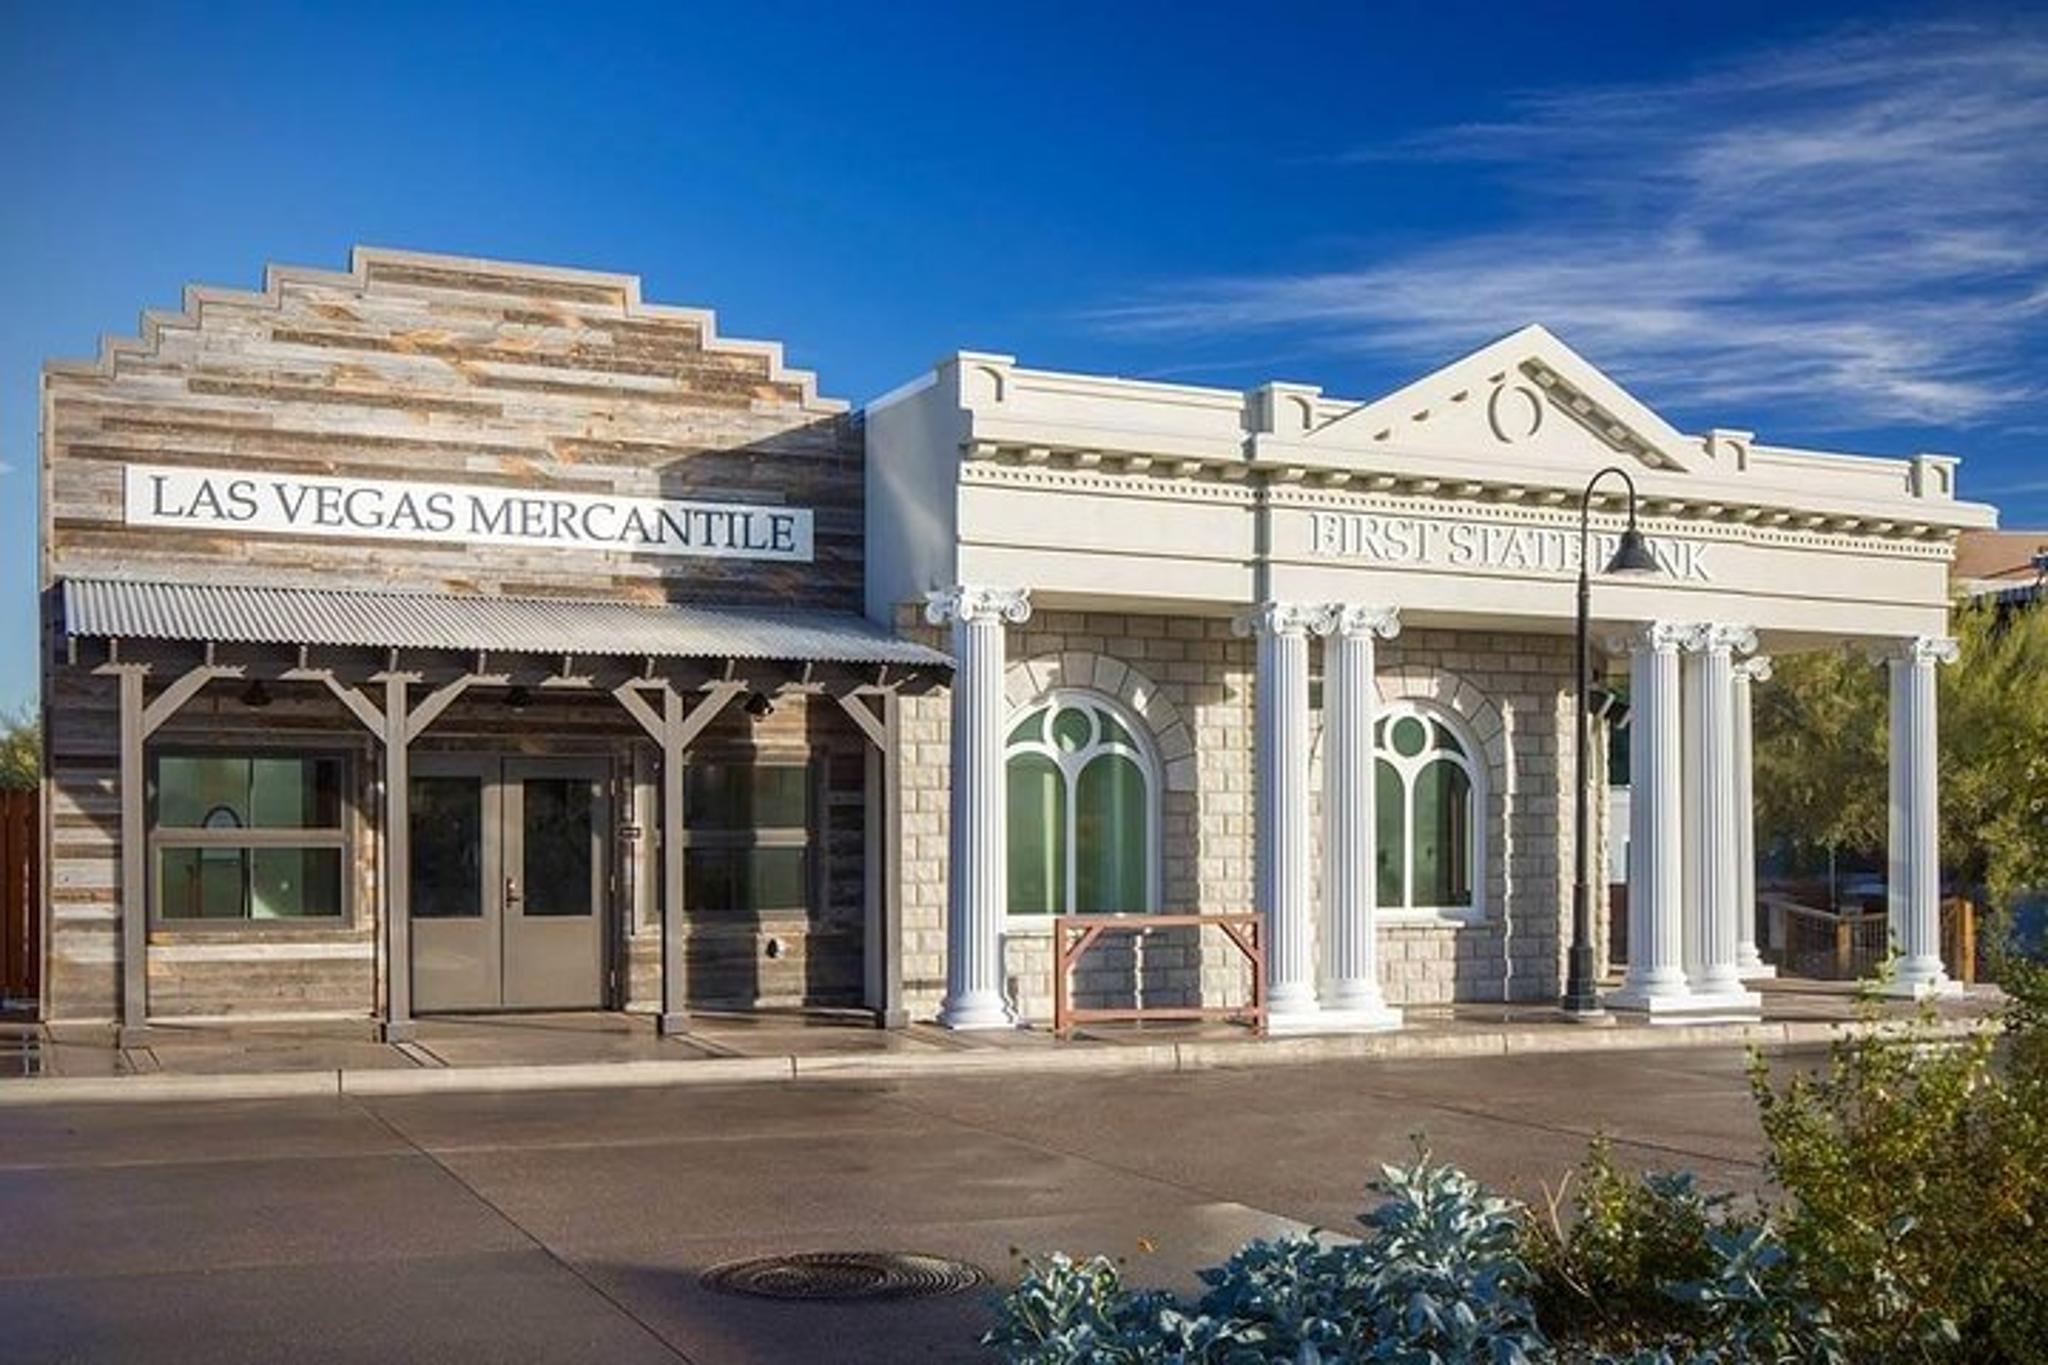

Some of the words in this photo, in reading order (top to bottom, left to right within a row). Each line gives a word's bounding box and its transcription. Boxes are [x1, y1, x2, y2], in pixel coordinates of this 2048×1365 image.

[152, 475, 259, 521] LAS
[273, 484, 455, 532] VEGAS
[467, 497, 796, 552] MERCANTILE
[1309, 512, 1439, 563] FIRST
[1448, 523, 1582, 573] STATE
[1592, 533, 1711, 582] BNK
